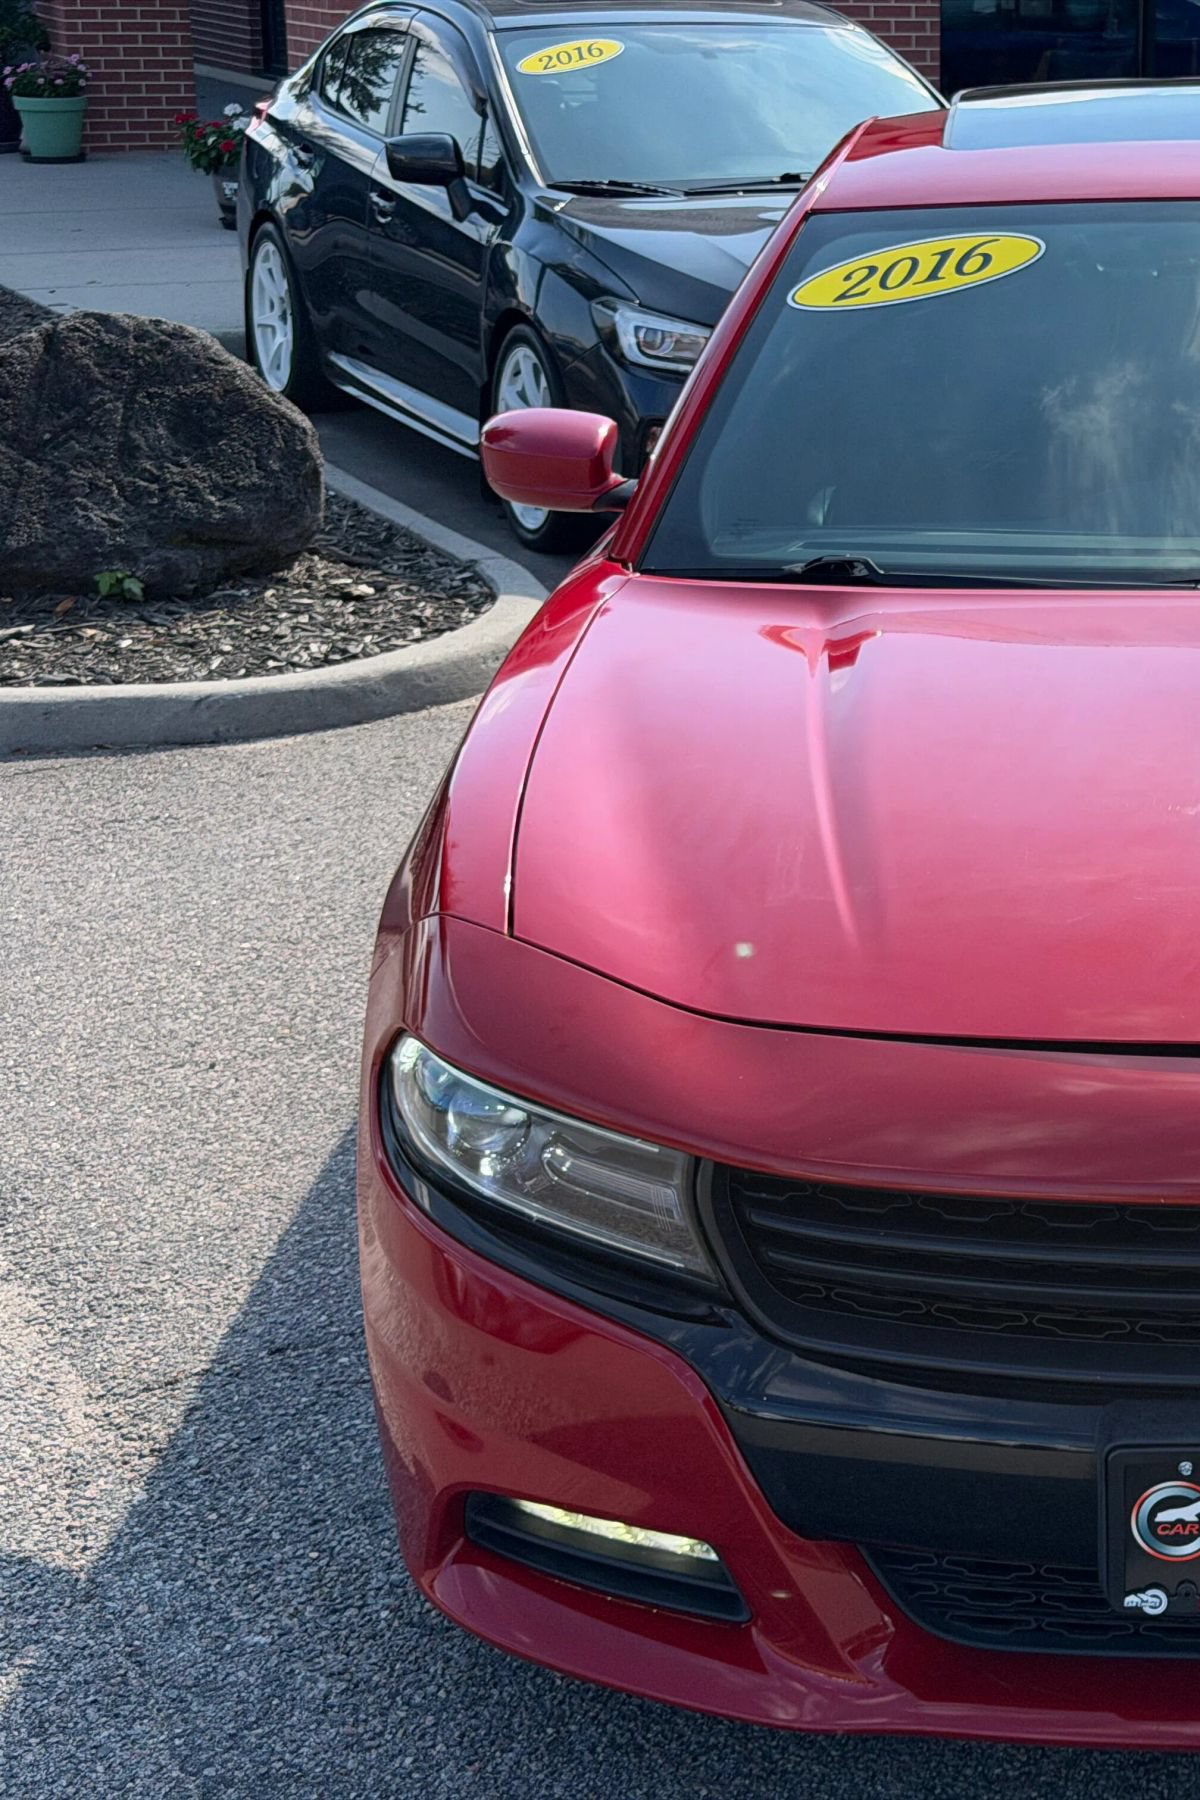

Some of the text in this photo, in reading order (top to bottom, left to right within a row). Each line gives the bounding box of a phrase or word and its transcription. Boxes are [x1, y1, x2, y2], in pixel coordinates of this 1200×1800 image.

[538, 41, 604, 71] 2016
[832, 238, 1001, 303] 2016
[1156, 1523, 1200, 1536] CAR
